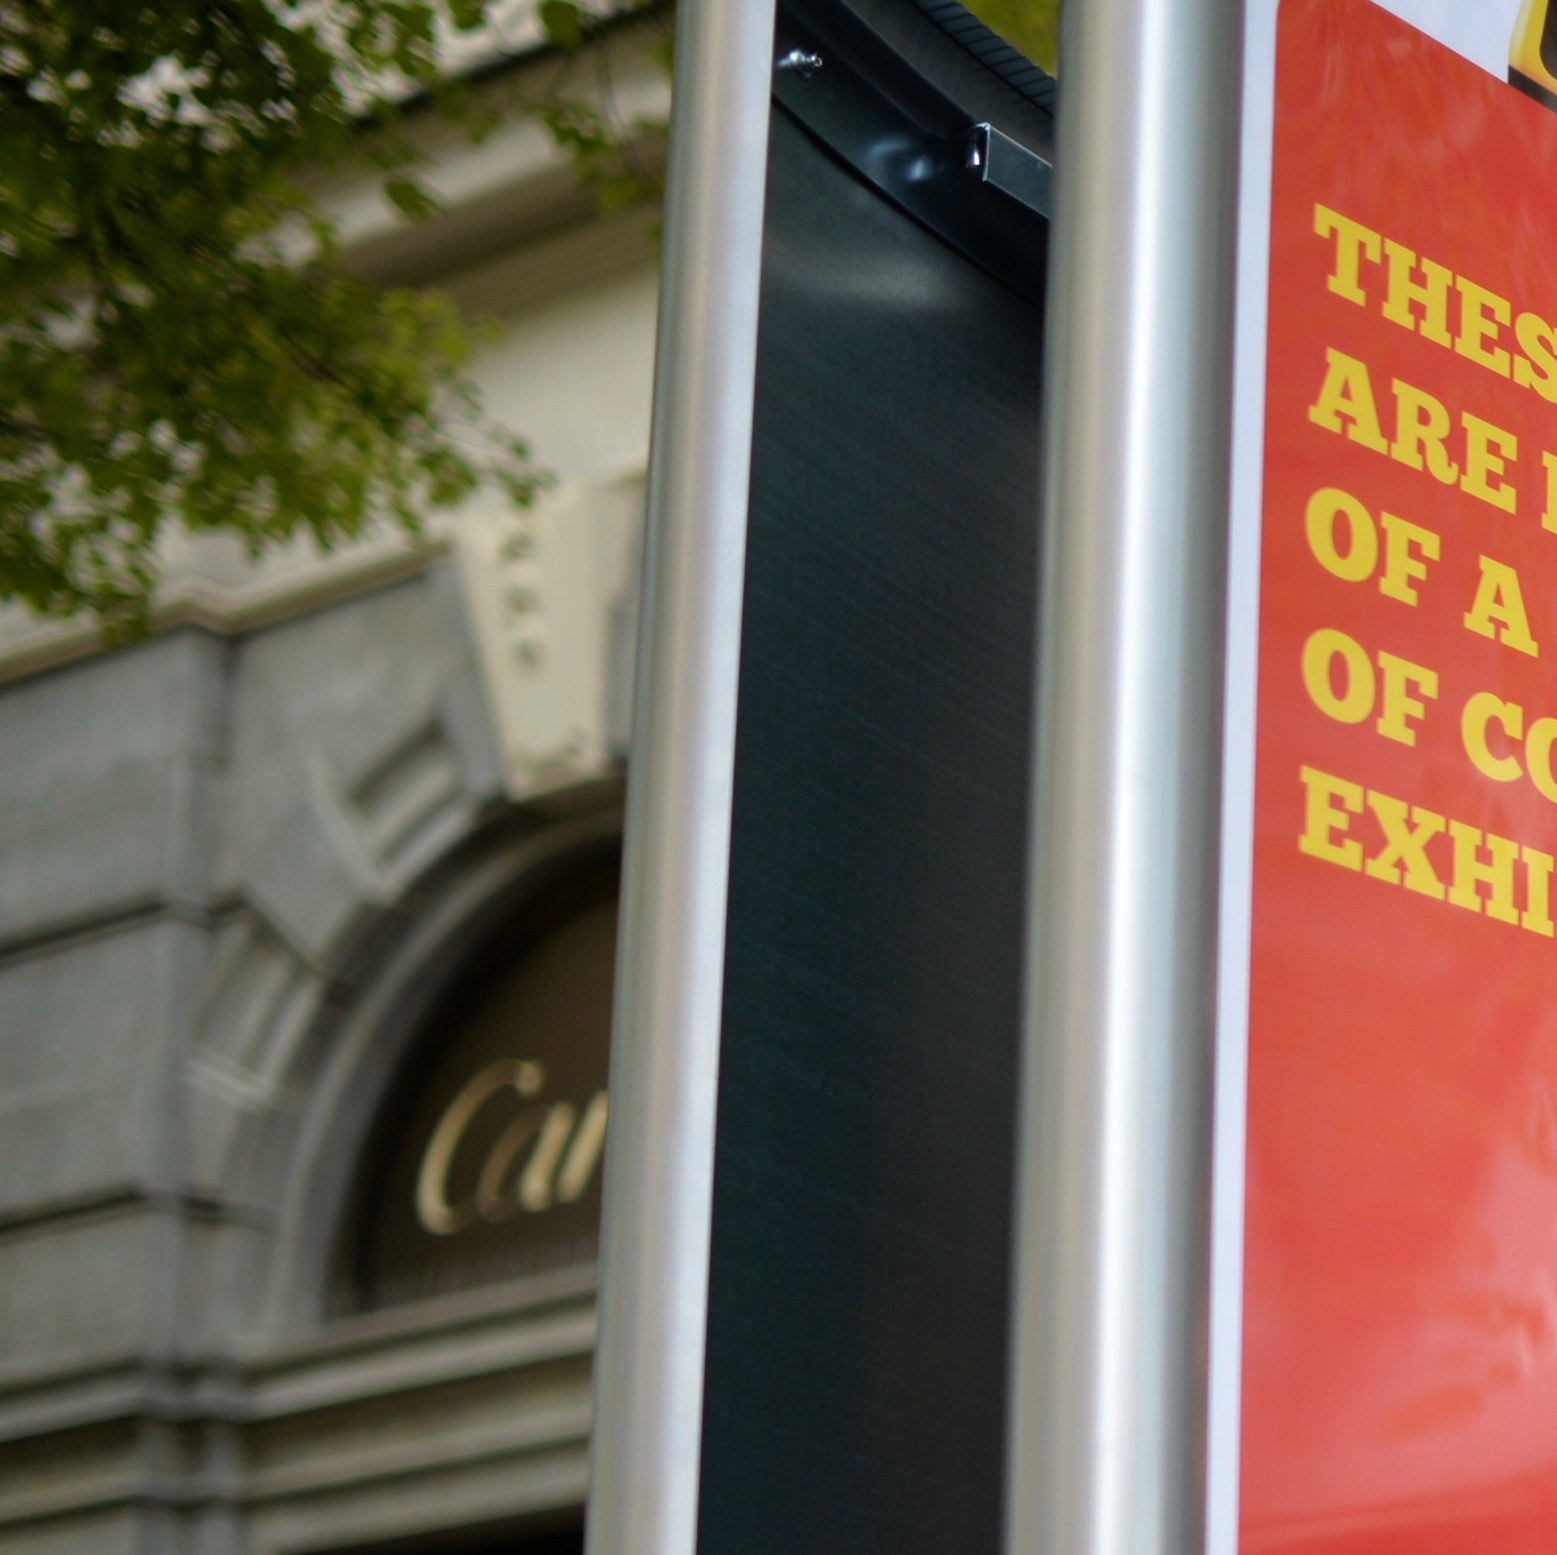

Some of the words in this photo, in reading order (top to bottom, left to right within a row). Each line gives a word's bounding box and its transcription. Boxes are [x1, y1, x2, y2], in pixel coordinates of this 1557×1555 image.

[1308, 347, 1518, 514] ARE
[1304, 487, 1441, 607] OF
[1463, 555, 1539, 657] A
[1302, 628, 1439, 747] OF
